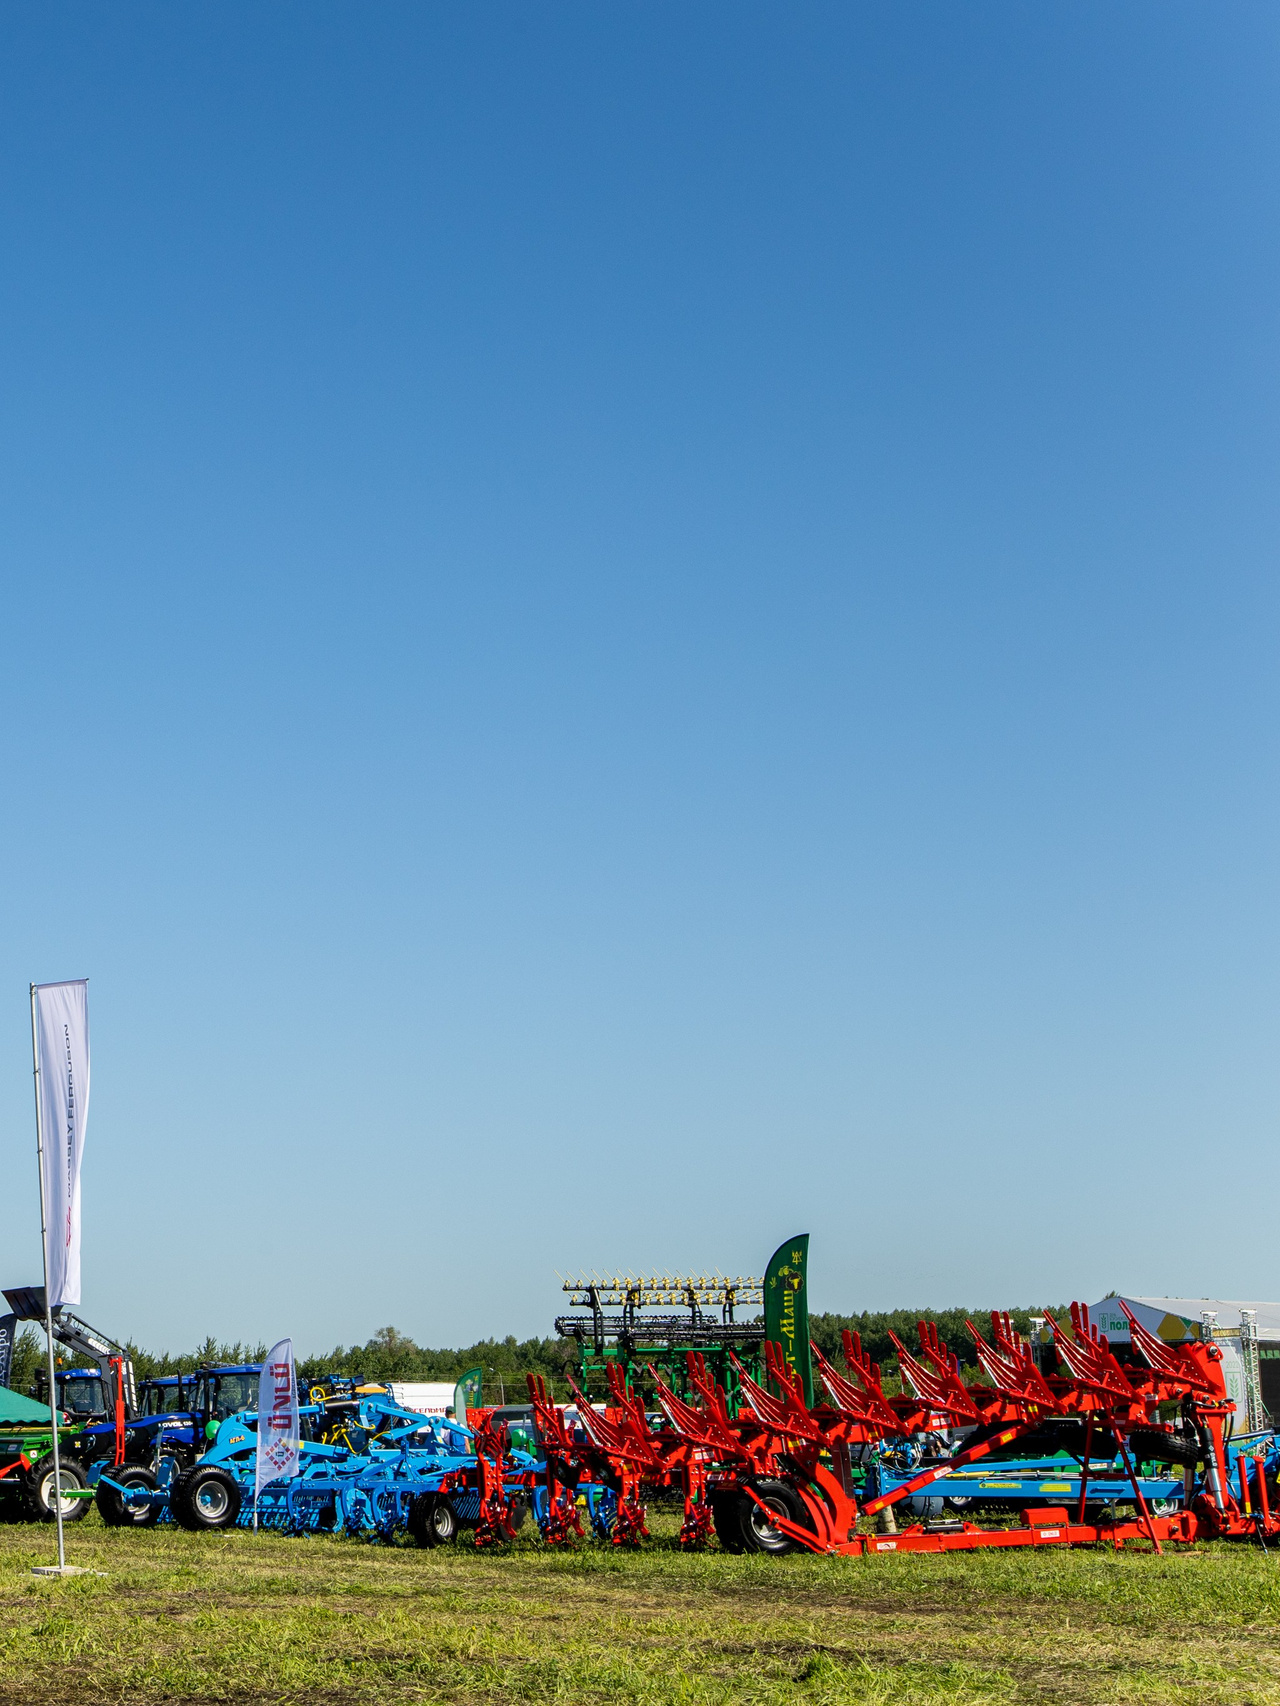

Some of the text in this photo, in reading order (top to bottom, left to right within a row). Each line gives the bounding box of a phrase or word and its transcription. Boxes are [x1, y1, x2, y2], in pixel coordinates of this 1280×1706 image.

[63, 1023, 74, 1119] FERGUSON
[1110, 1321, 1130, 1331] ПОЛ
[267, 1363, 292, 1431] ÜNLÜ
